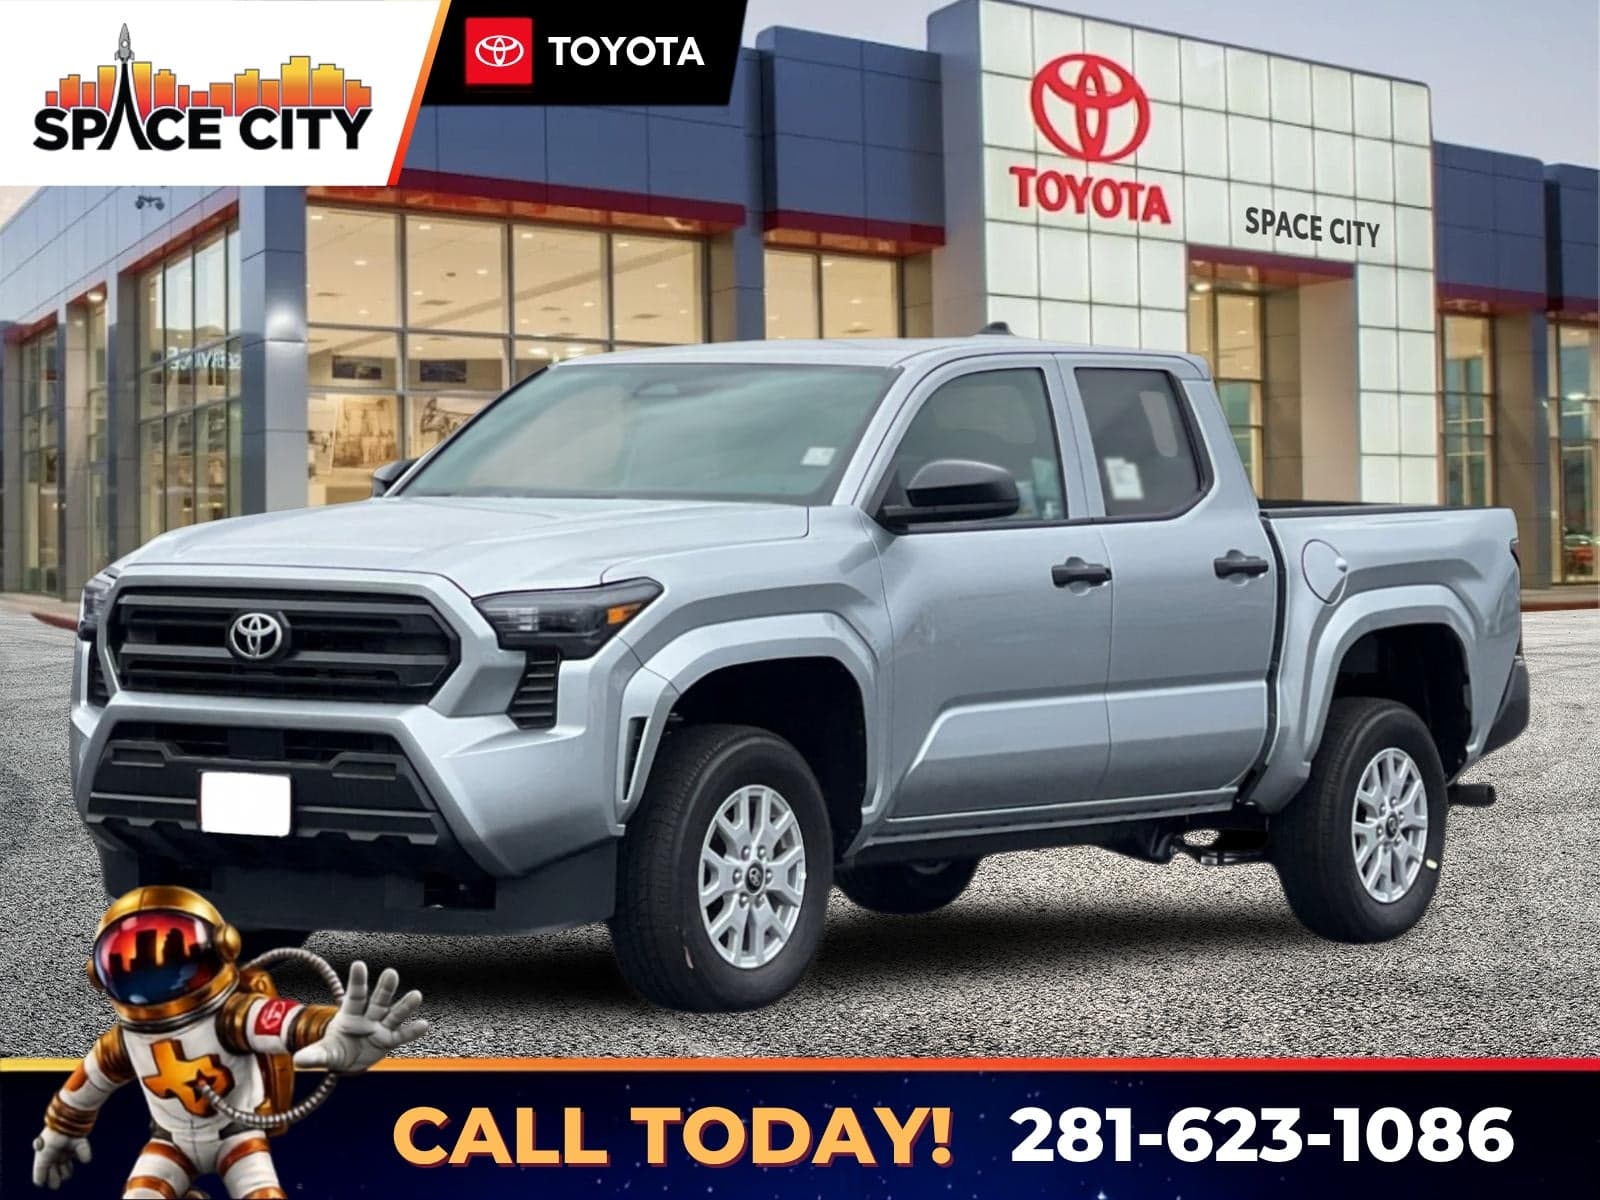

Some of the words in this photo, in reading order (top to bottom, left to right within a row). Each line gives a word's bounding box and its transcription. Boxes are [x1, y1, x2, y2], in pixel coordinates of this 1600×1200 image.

[1009, 165, 1171, 225] TOYOTA
[1245, 206, 1323, 242] SPACE
[1329, 217, 1381, 248] CITY
